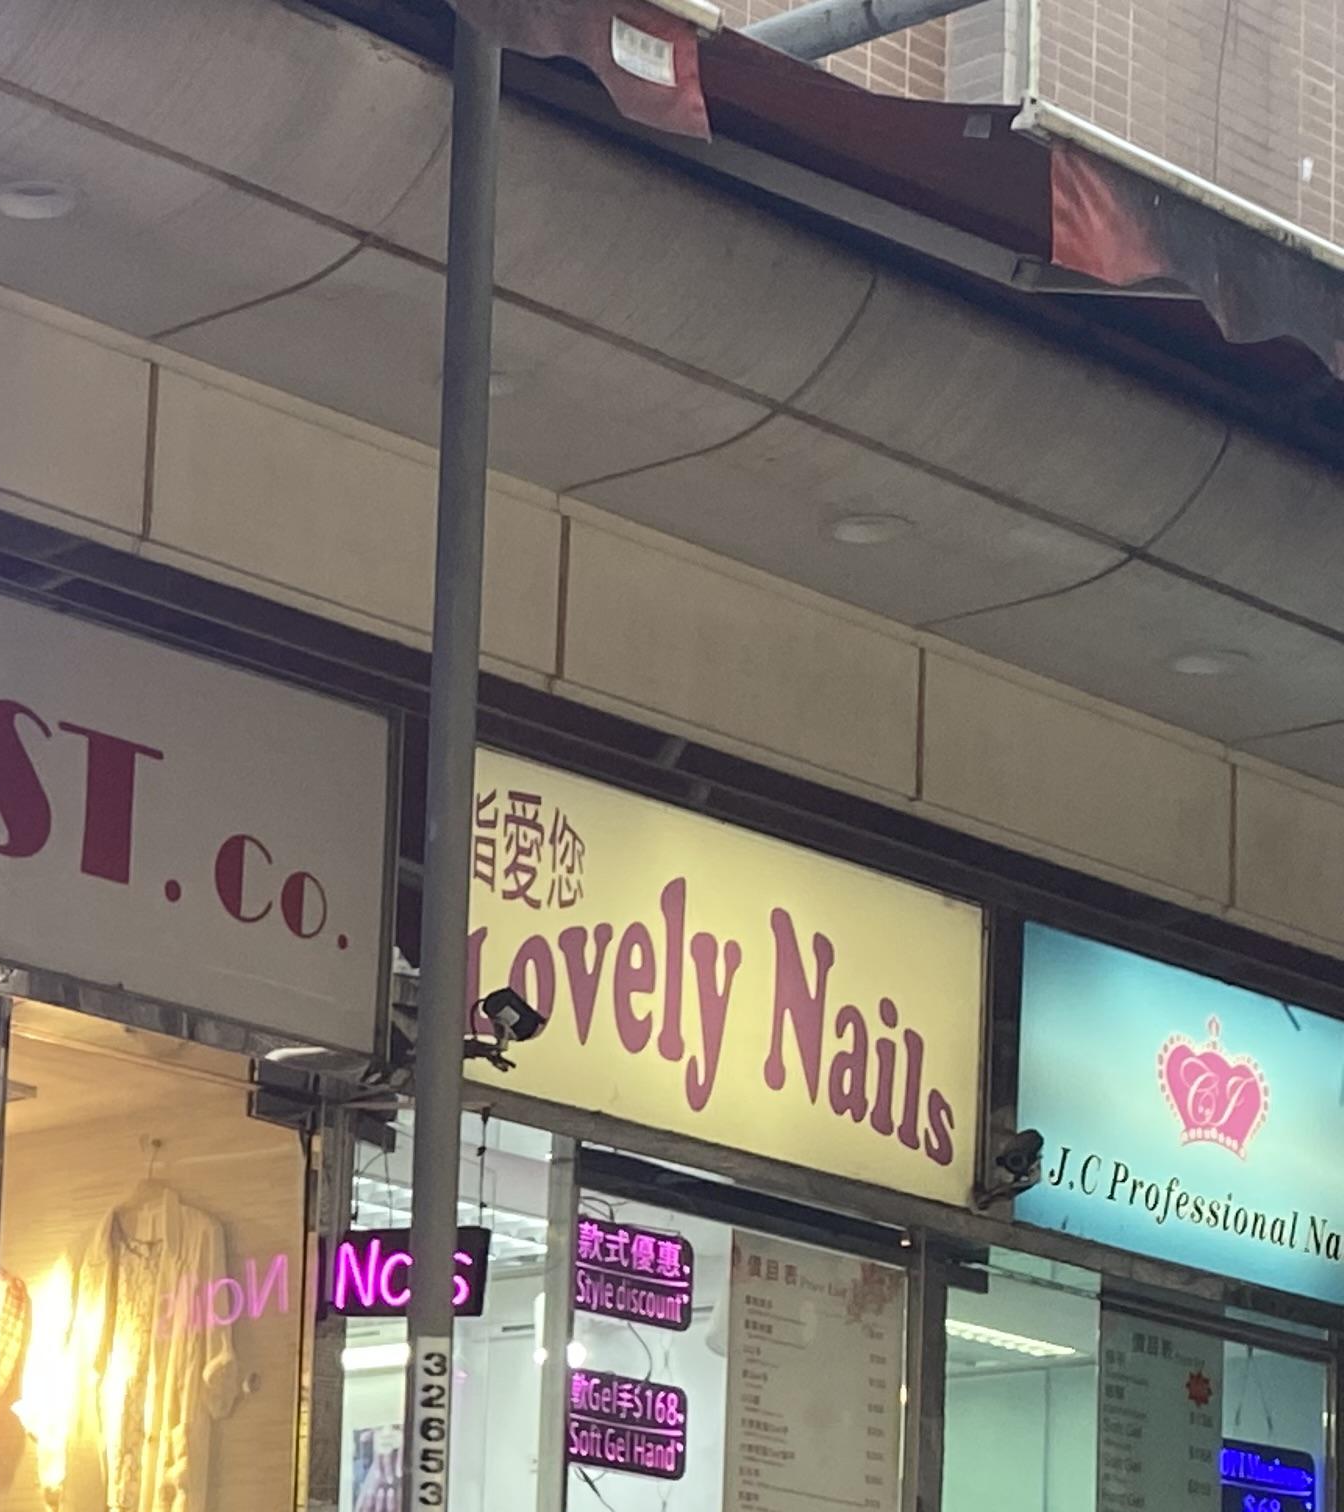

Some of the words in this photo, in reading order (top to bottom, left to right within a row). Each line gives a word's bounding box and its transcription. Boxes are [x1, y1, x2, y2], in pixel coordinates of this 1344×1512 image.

[764, 906, 956, 1167] Nails
[1106, 1161, 1298, 1251] Professional
[578, 1221, 683, 1279] 款式優惠
[576, 1269, 614, 1312] Style
[616, 1280, 683, 1325] discount
[418, 1351, 448, 1507] 32653
[569, 1422, 603, 1458] Soft
[605, 1428, 631, 1464] Gel
[633, 1433, 676, 1472] Hand
